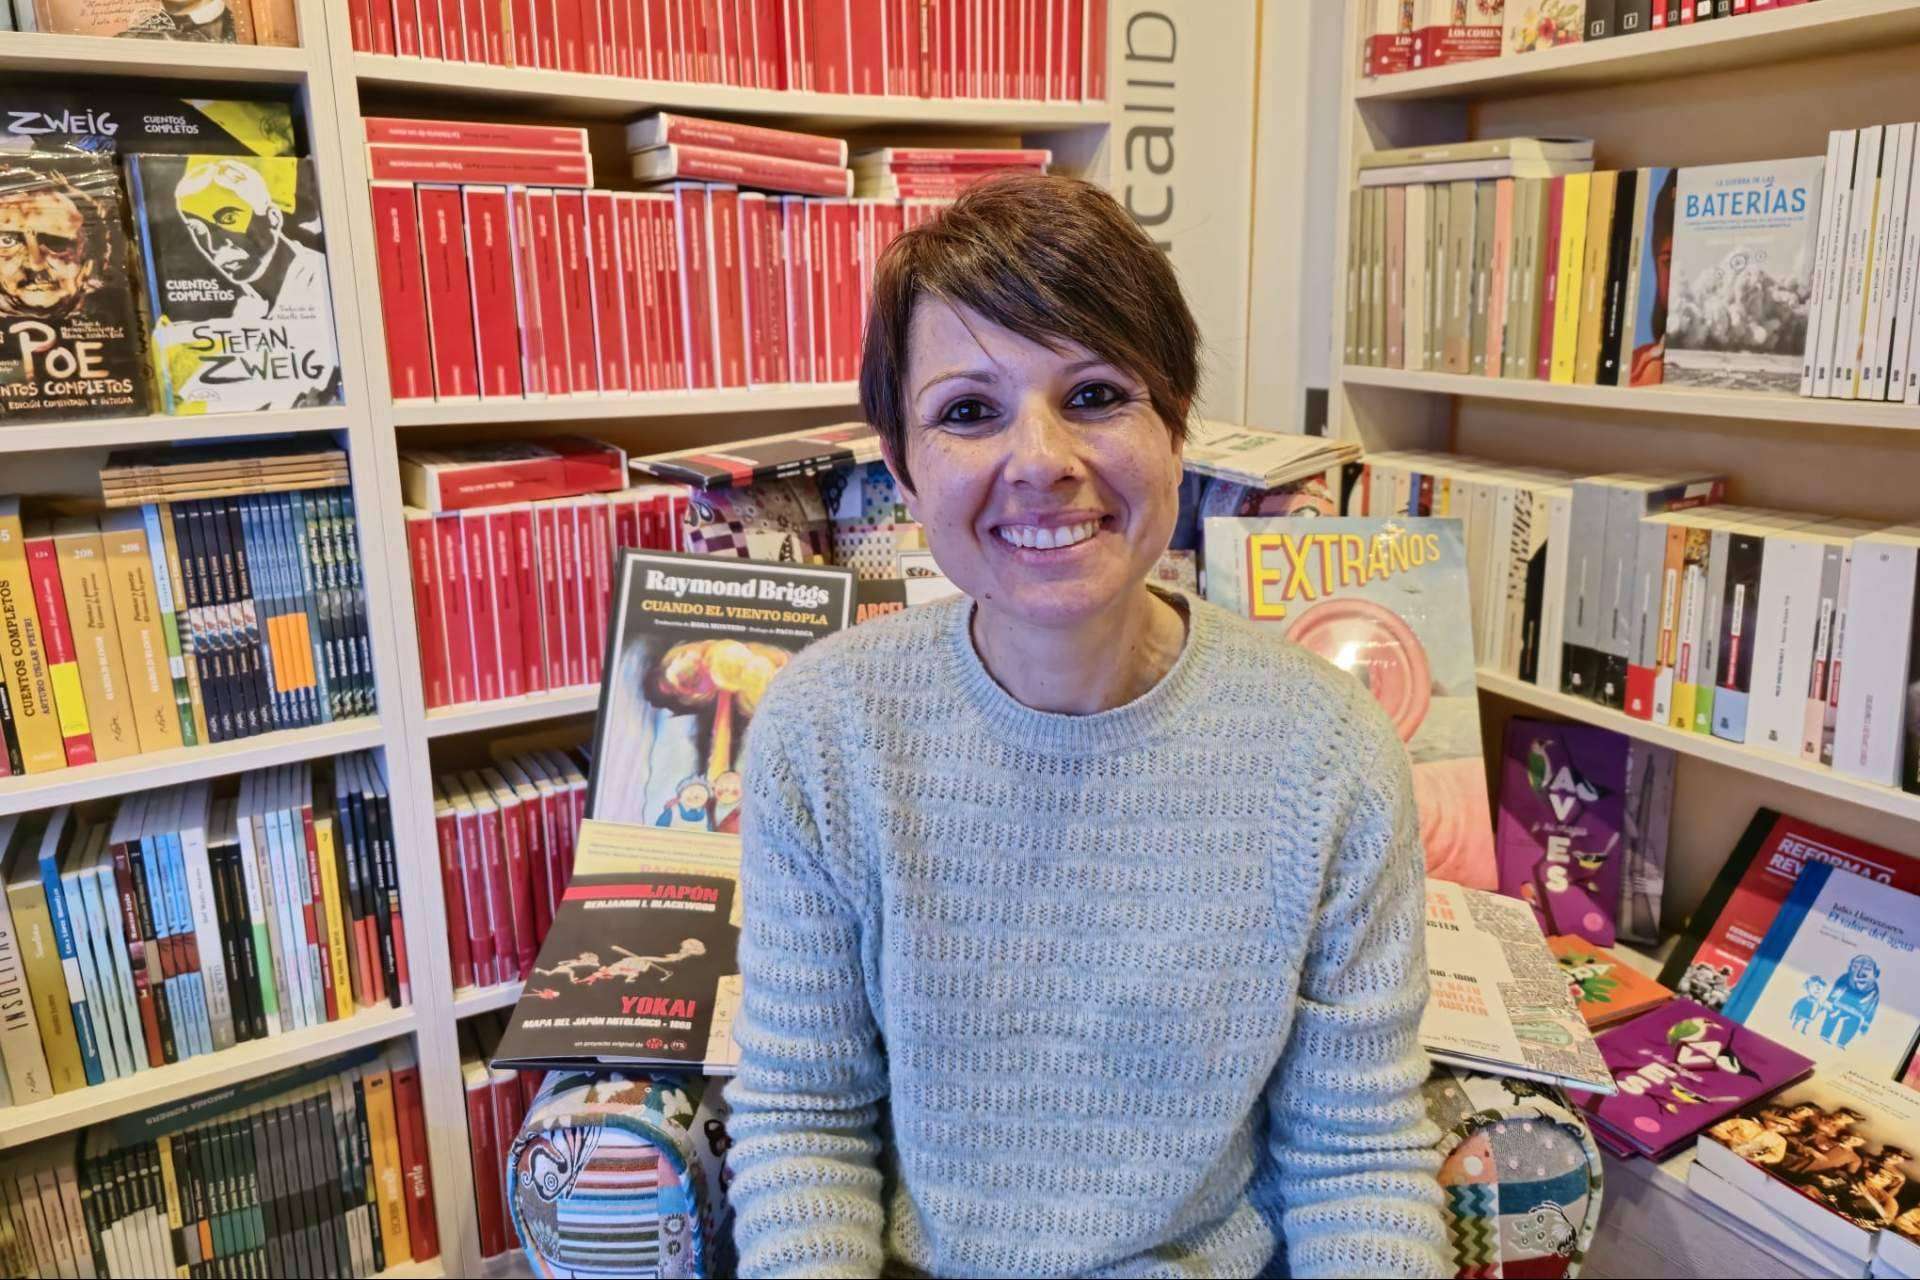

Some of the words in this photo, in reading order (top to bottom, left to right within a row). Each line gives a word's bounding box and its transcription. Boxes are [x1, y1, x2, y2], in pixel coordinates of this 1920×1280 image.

[1686, 182, 1807, 217] BATERÍAS
[166, 279, 219, 291] CUENTOS
[168, 289, 235, 301] COMPLETOS
[9, 320, 109, 381] POE
[199, 349, 324, 384] ZWEIG
[44, 379, 133, 395] COMPLETOS
[1247, 526, 1441, 621] EXTRAÑOS
[645, 569, 757, 598] Raymond
[758, 579, 829, 609] Briggs
[0, 580, 24, 656] COMPLETOS
[641, 599, 704, 615] CUANDO
[704, 604, 725, 617] EL
[726, 607, 781, 621] VIENTO
[782, 611, 829, 625] SOPLA
[23, 617, 36, 647] PIETRI
[30, 648, 42, 677] USLAR
[13, 659, 35, 717] CUENTOS
[35, 679, 50, 714] ARTURO
[651, 884, 719, 902] JAPÓN
[621, 995, 697, 1018] YOKAI
[522, 1019, 552, 1029] MAPA
[553, 1018, 570, 1027] DEL
[572, 1016, 605, 1027] JAPÓN
